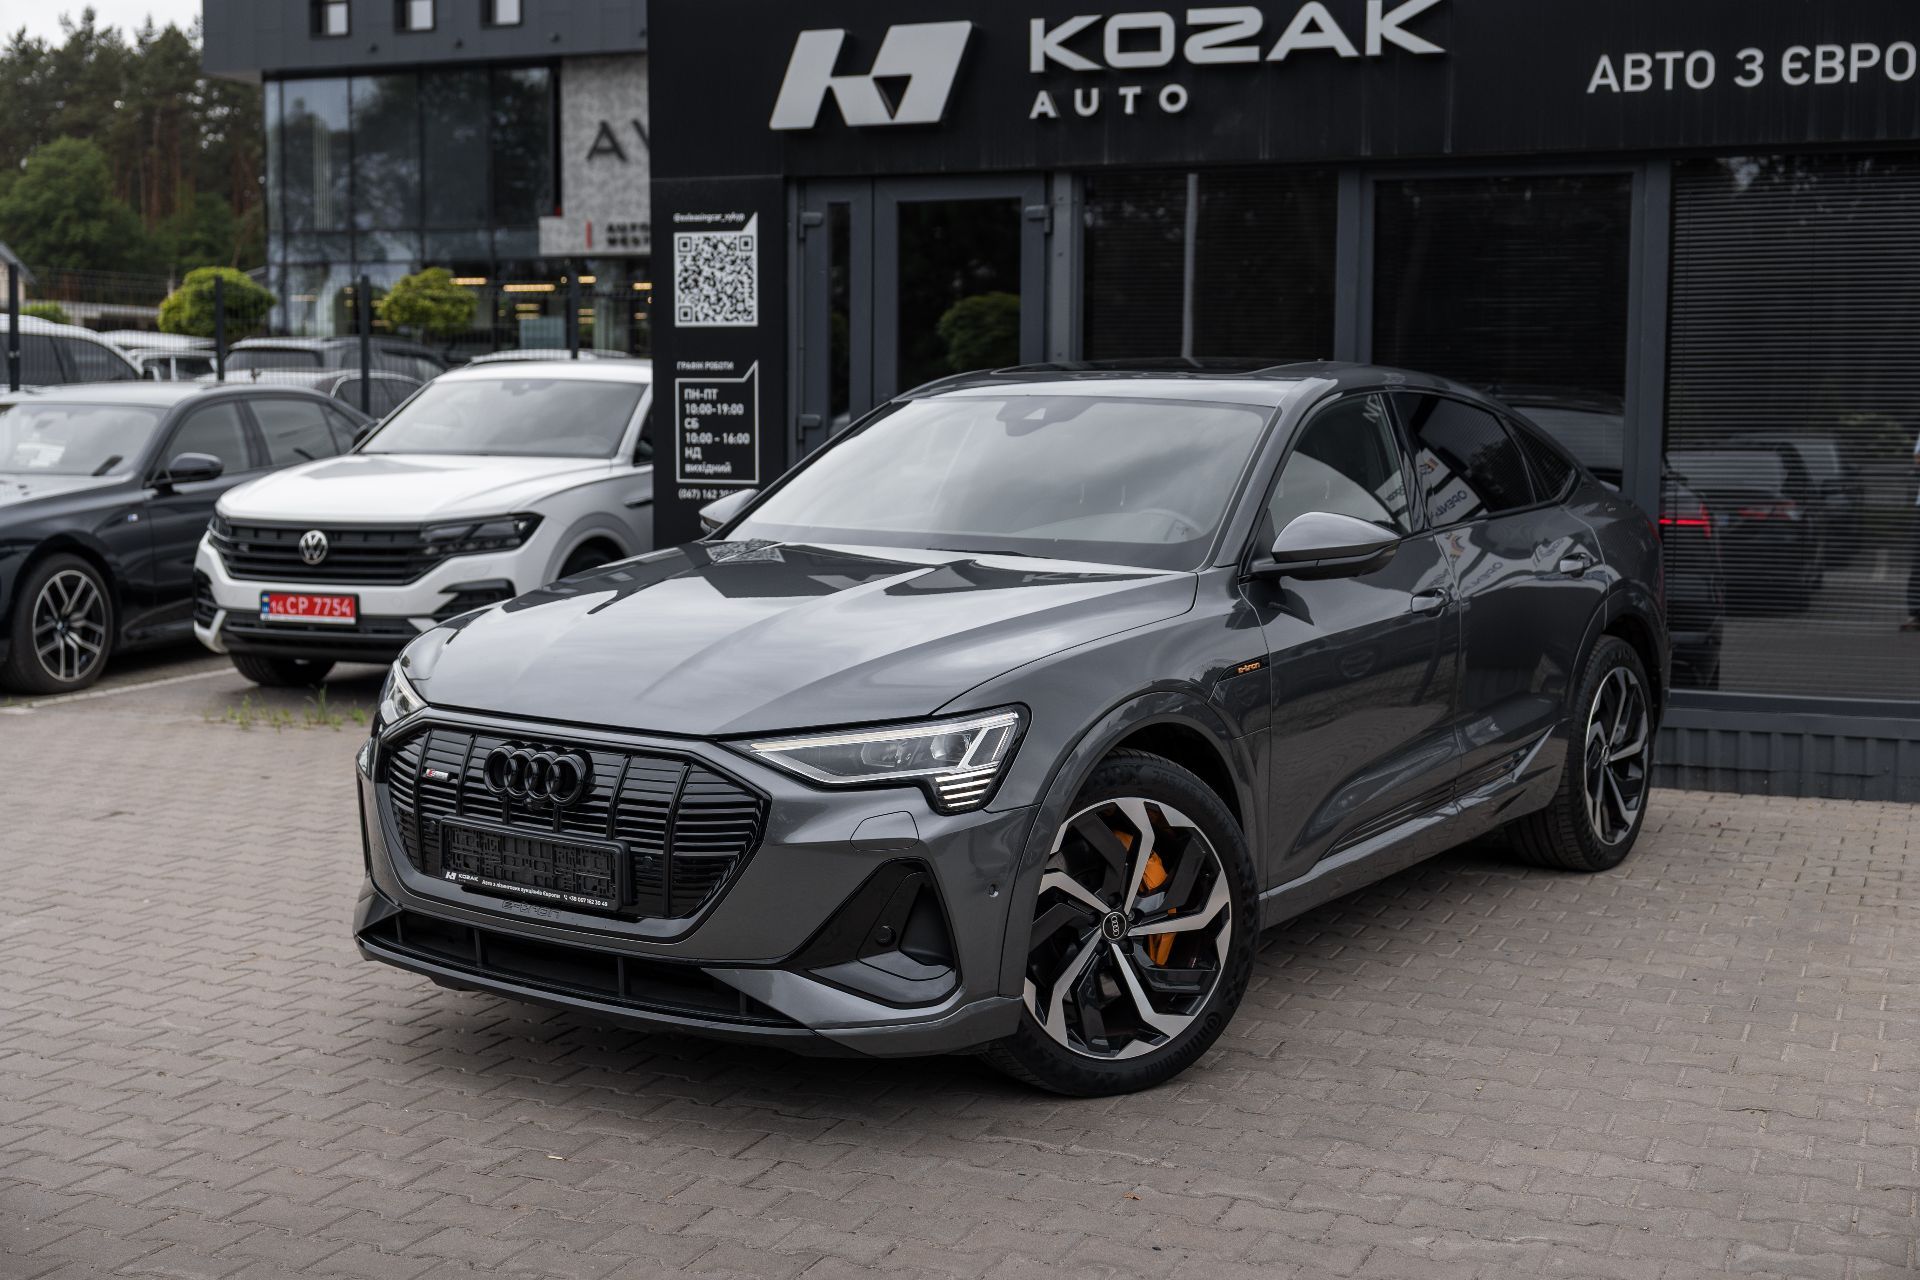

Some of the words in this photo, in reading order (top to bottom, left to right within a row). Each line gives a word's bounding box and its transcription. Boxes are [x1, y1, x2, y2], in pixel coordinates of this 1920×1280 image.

[1029, 0, 1447, 73] KOZAK
[1586, 51, 1716, 93] АВТО
[1733, 47, 1764, 87] З
[1781, 41, 1917, 85] ЄВРО
[1028, 84, 1189, 119] AUTO
[684, 388, 719, 400] ПН-ПТ
[685, 403, 744, 415] 10:00-19:00
[684, 417, 699, 430] СБ
[685, 432, 713, 444] 10:00
[722, 432, 750, 444] 16:00
[684, 446, 702, 460] НД
[685, 461, 732, 475] вихідний
[678, 488, 701, 500] (067)
[702, 488, 718, 500] 162
[286, 596, 309, 615] CP
[313, 597, 351, 617] 7754
[1238, 662, 1260, 674] e-tron
